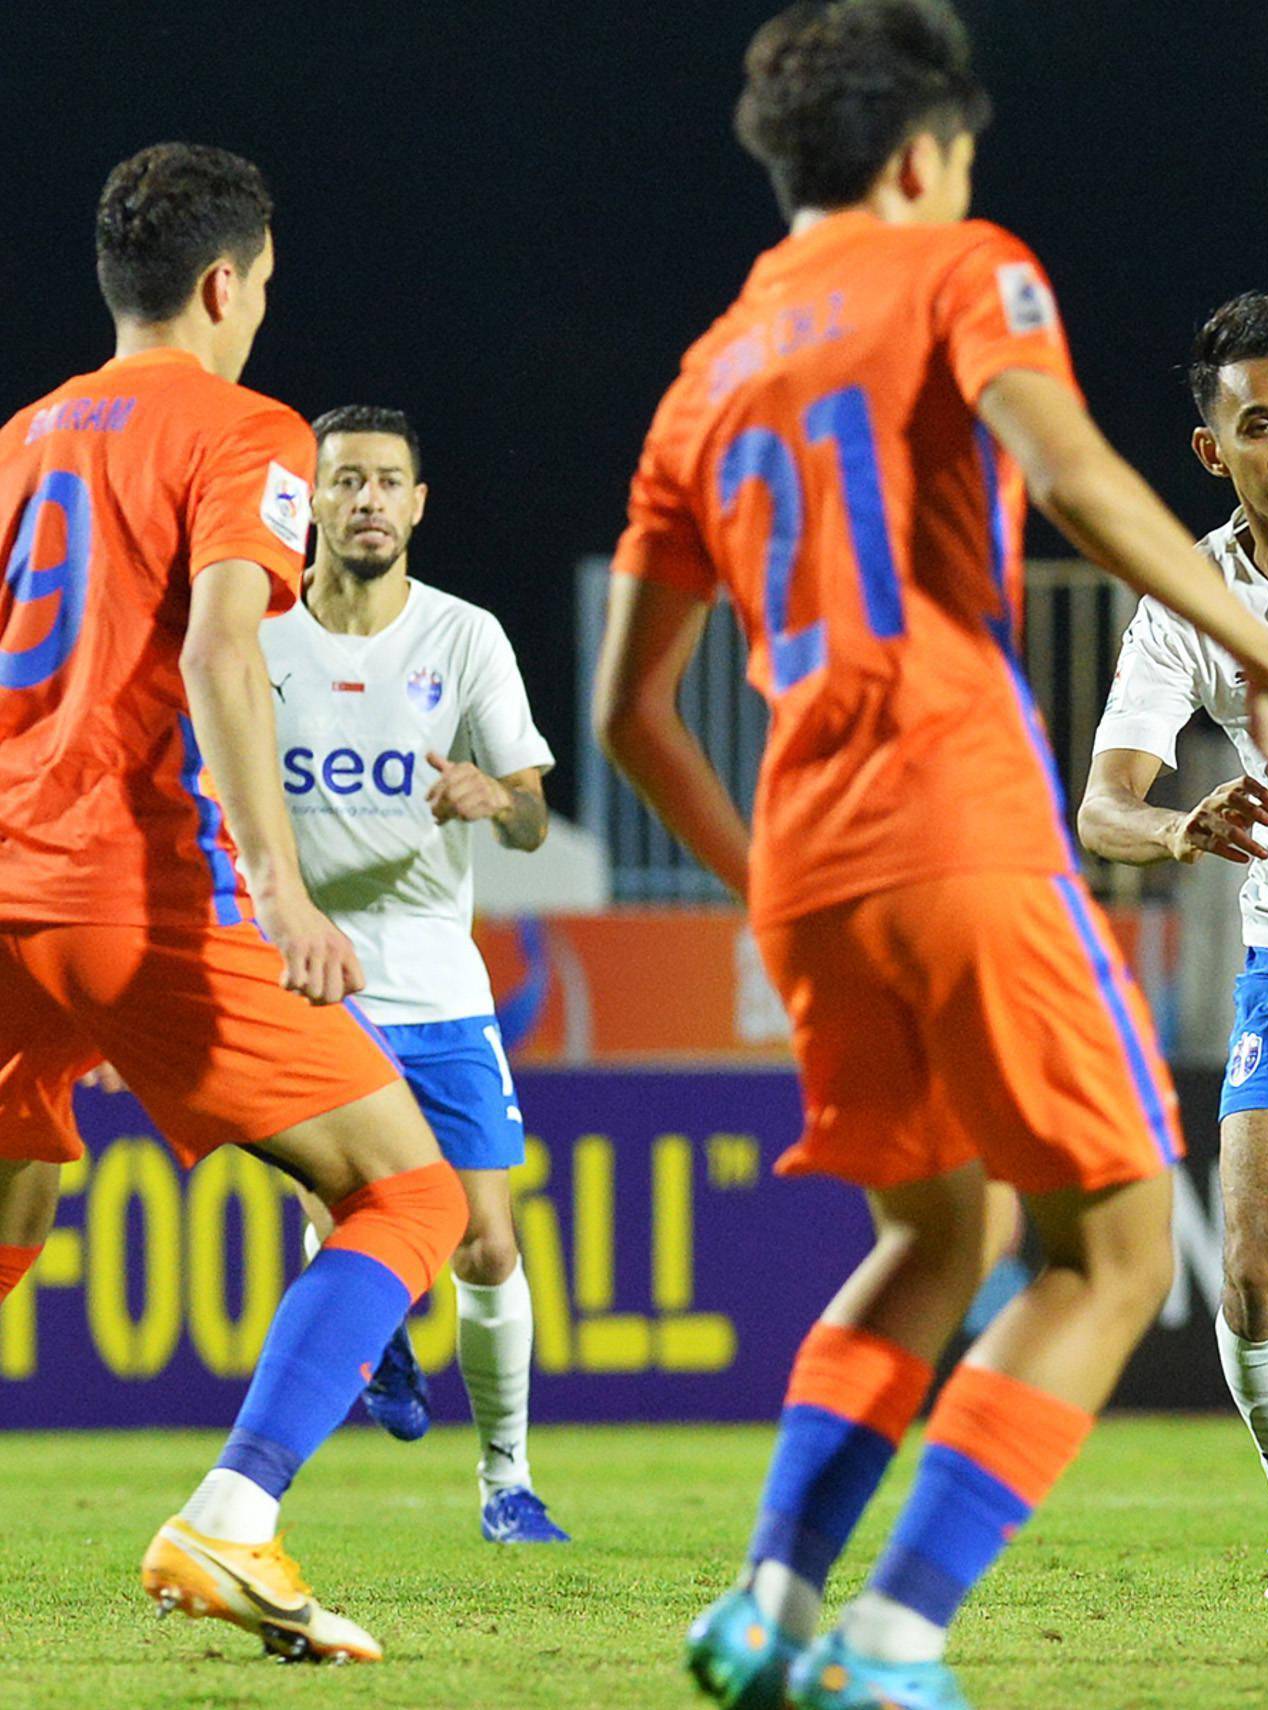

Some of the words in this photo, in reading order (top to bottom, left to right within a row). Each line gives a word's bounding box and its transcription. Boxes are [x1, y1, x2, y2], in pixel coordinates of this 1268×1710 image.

[0, 470, 92, 690] 9
[717, 383, 906, 693] 21
[283, 747, 416, 796] sea
